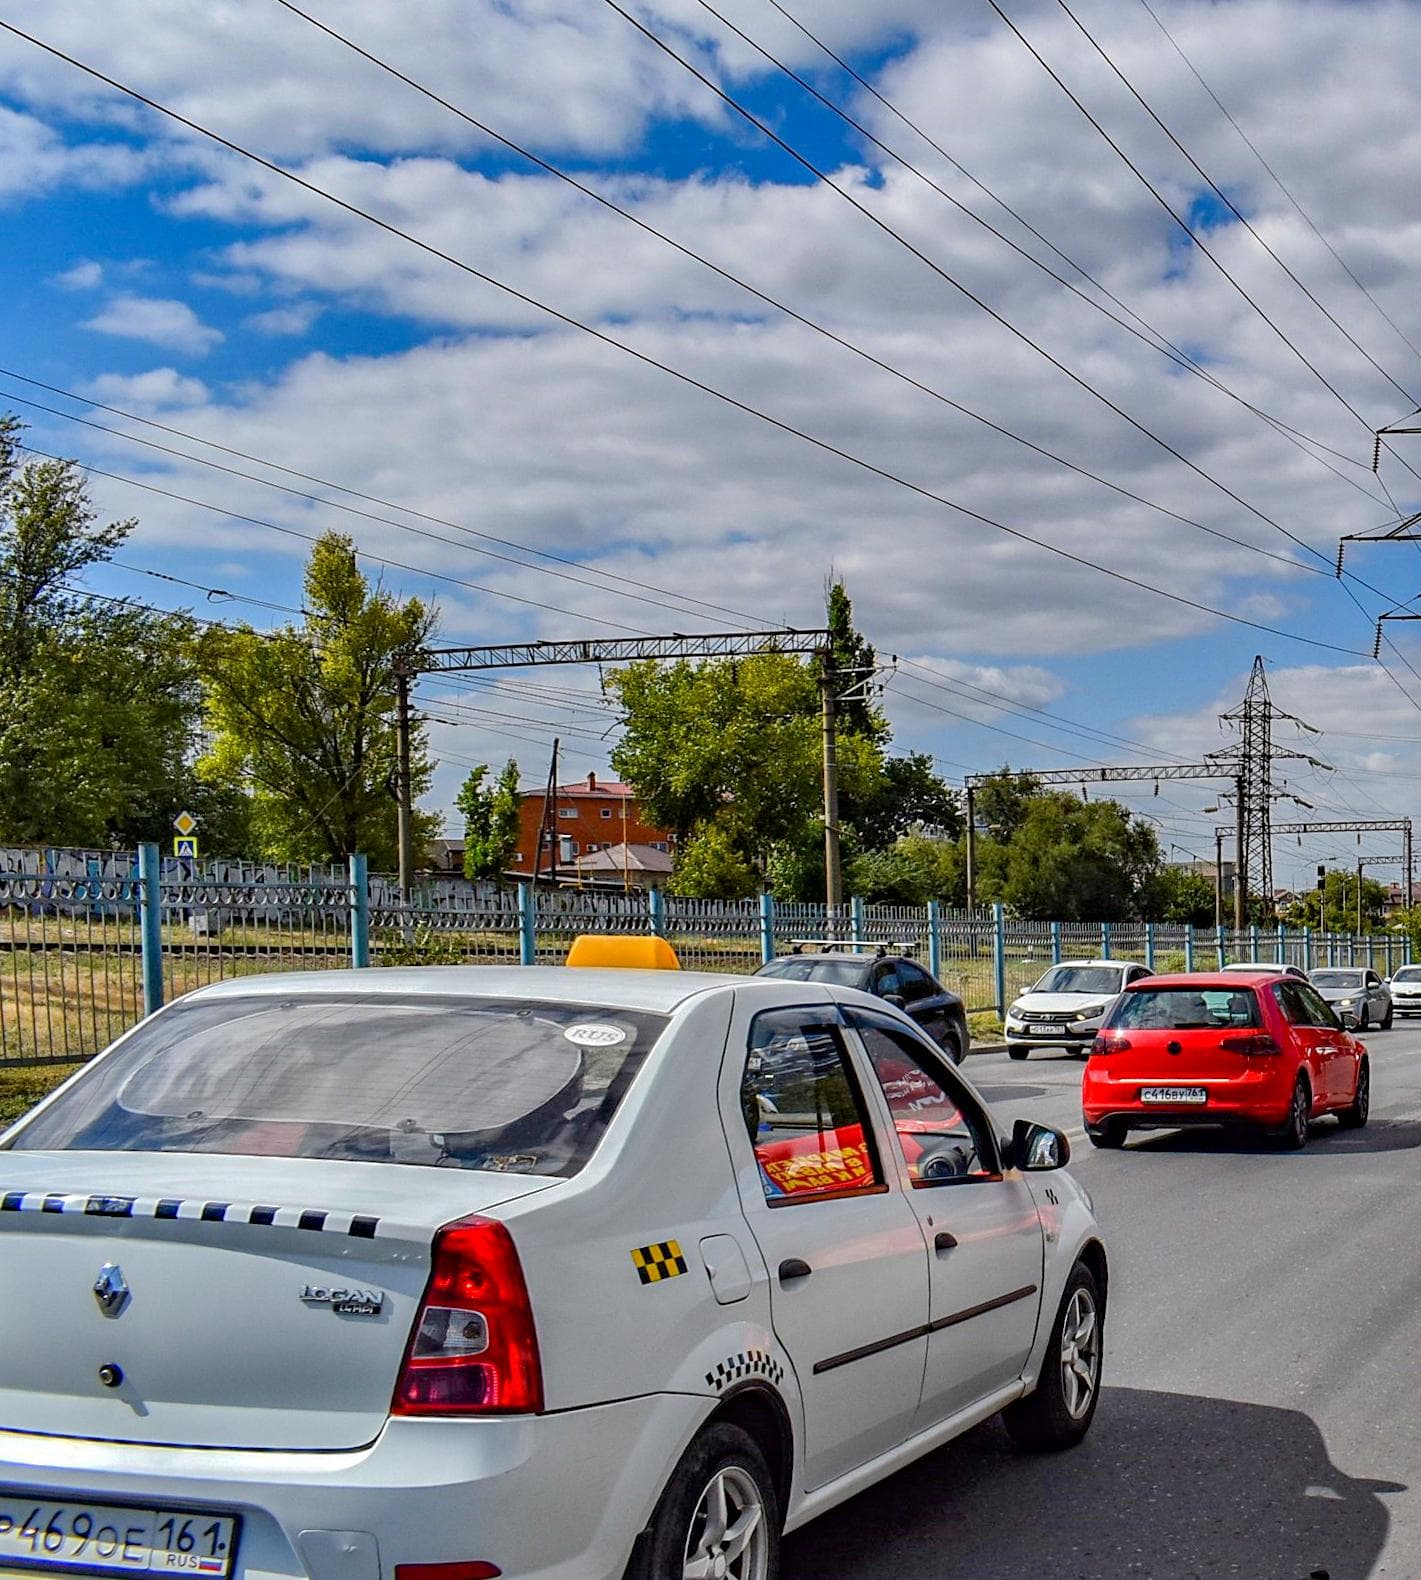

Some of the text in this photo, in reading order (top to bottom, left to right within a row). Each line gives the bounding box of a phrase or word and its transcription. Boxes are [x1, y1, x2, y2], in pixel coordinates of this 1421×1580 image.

[572, 1028, 619, 1041] RUS
[299, 1285, 385, 1304] LOGAN
[166, 1554, 198, 1569] RUS
